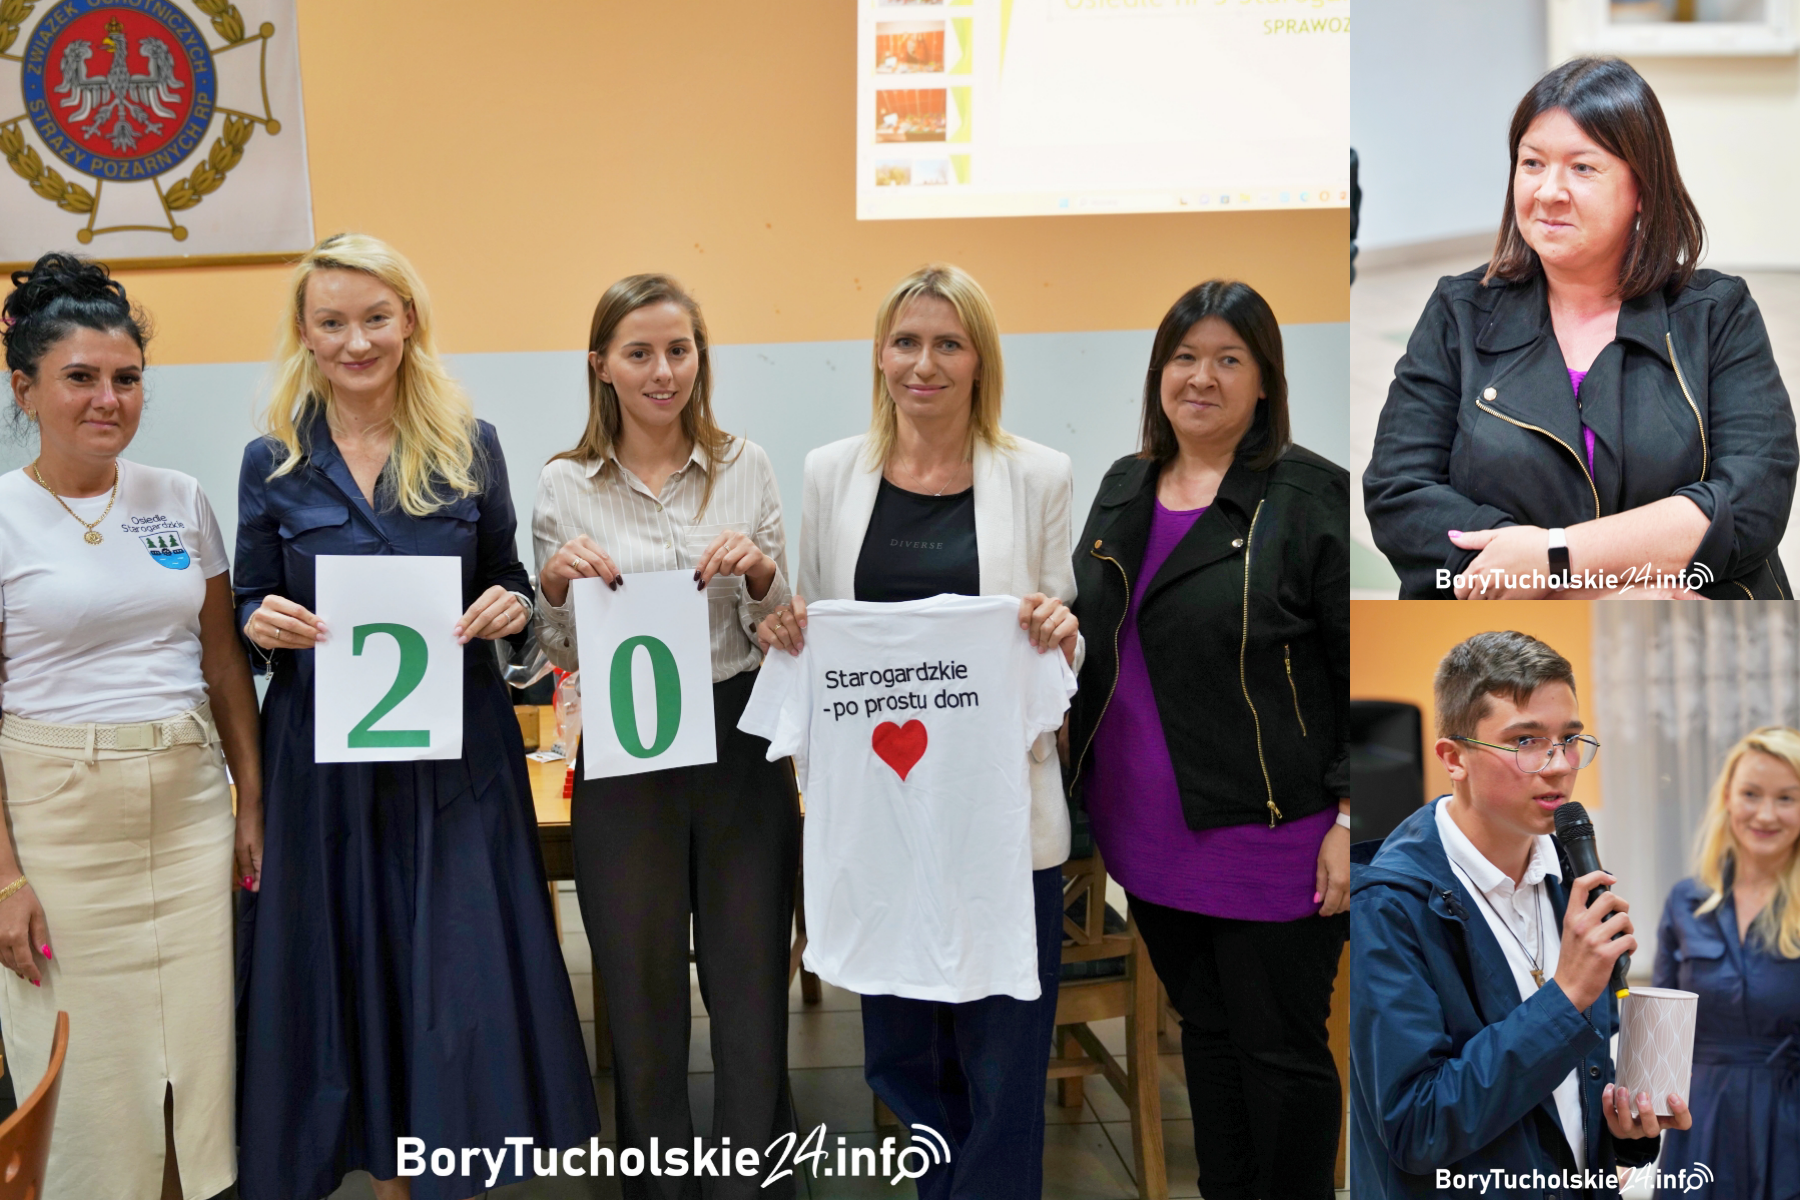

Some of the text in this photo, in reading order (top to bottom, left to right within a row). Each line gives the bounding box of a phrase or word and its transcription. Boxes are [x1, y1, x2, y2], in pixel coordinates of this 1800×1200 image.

[193, 92, 212, 120] RP
[121, 520, 186, 533] Starogardzkie
[131, 514, 168, 525] Osiedle
[889, 538, 944, 550] DIVERSE
[348, 623, 431, 748] 2
[825, 660, 968, 689] Starogardzkie
[865, 691, 928, 718] prostu
[934, 689, 979, 709] dom
